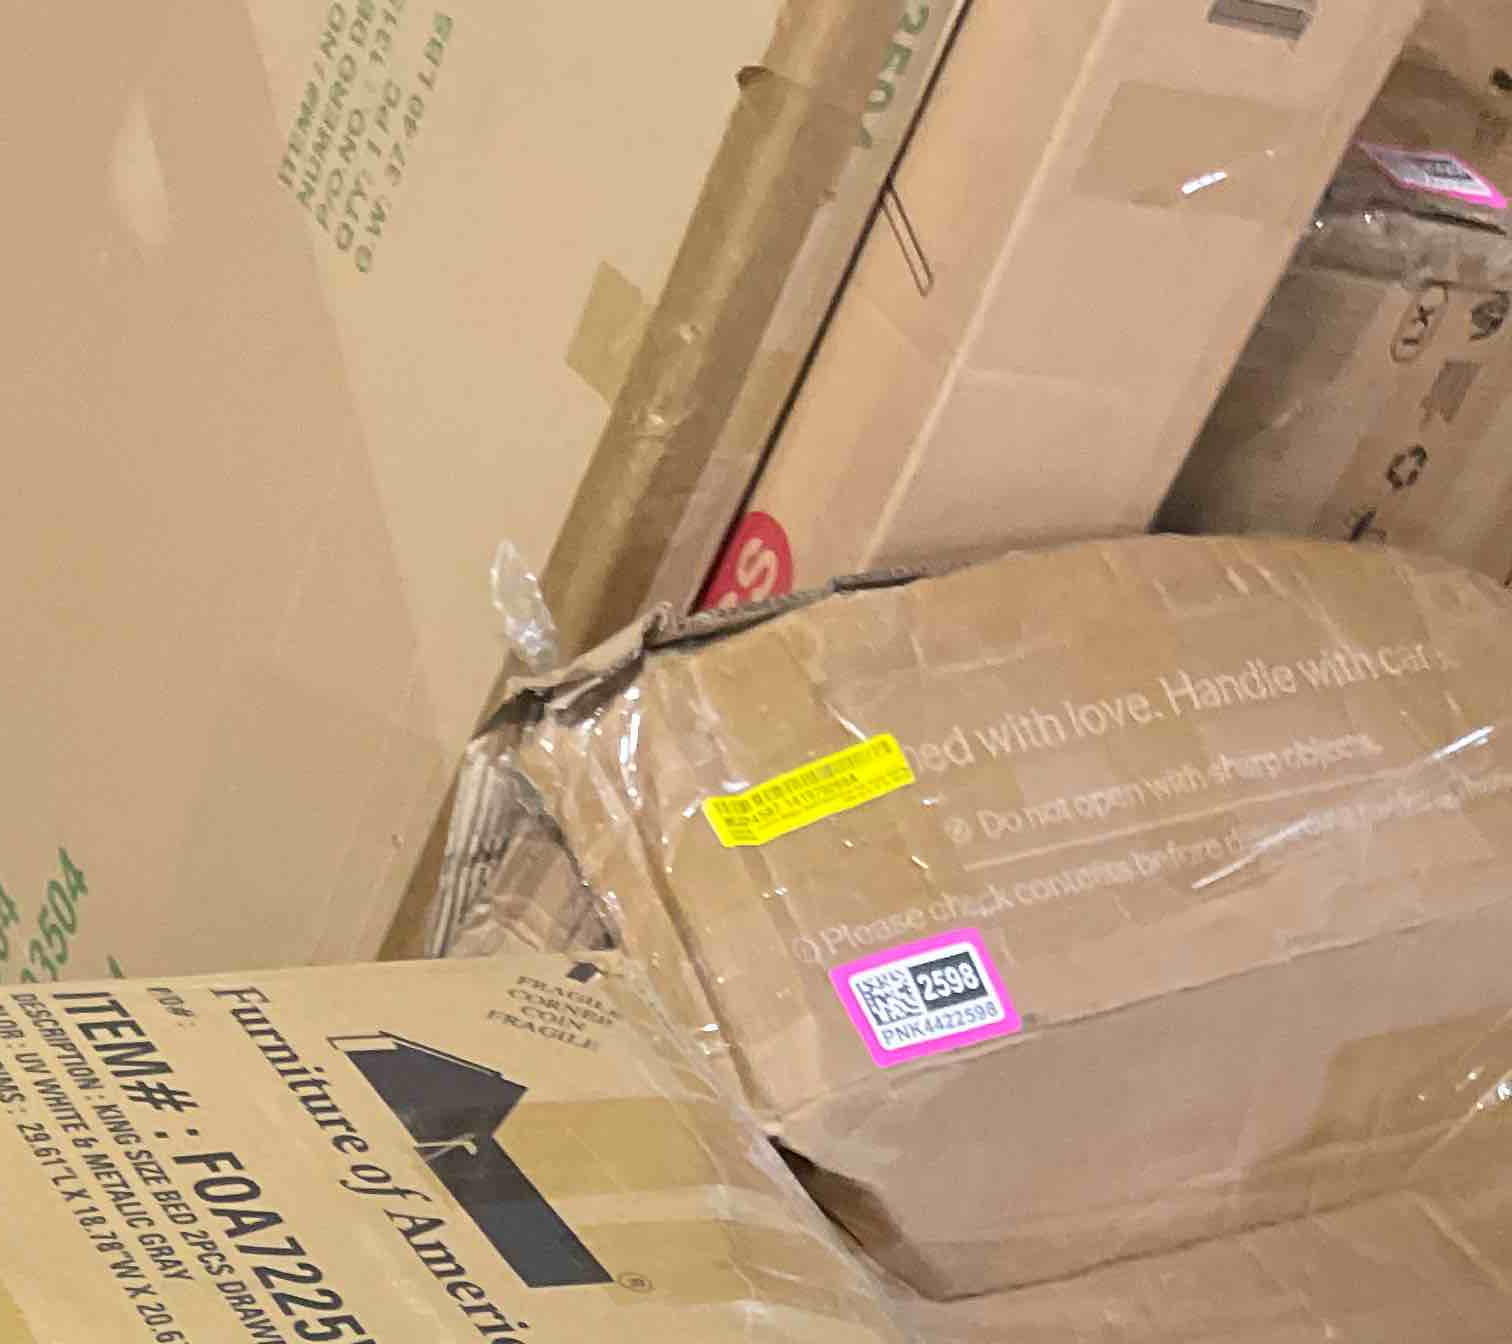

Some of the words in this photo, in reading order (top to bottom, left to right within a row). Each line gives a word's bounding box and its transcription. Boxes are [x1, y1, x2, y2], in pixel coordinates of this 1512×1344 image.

[975, 709, 1065, 764] with
[1163, 657, 1299, 715] Handle
[1296, 643, 1379, 690] with
[820, 905, 925, 958] Please
[917, 963, 979, 1001] 2598
[521, 1006, 585, 1032] COIN
[882, 1001, 1000, 1047] PNK4422598
[10, 1049, 51, 1077] UV
[50, 984, 179, 1115] ITEM#
[29, 1075, 90, 1134] WHITE
[208, 983, 369, 1153] Furniture
[327, 1160, 428, 1204] of
[13, 991, 107, 1091] DESCRIPTION
[89, 1101, 145, 1147] KING
[121, 1146, 173, 1186] SIZE
[149, 1186, 203, 1227] BED
[178, 1227, 237, 1277] 2PCS
[79, 1150, 156, 1231] METALIC
[59, 1186, 94, 1203] X
[121, 1281, 157, 1300] X
[132, 1229, 194, 1286] GRAY
